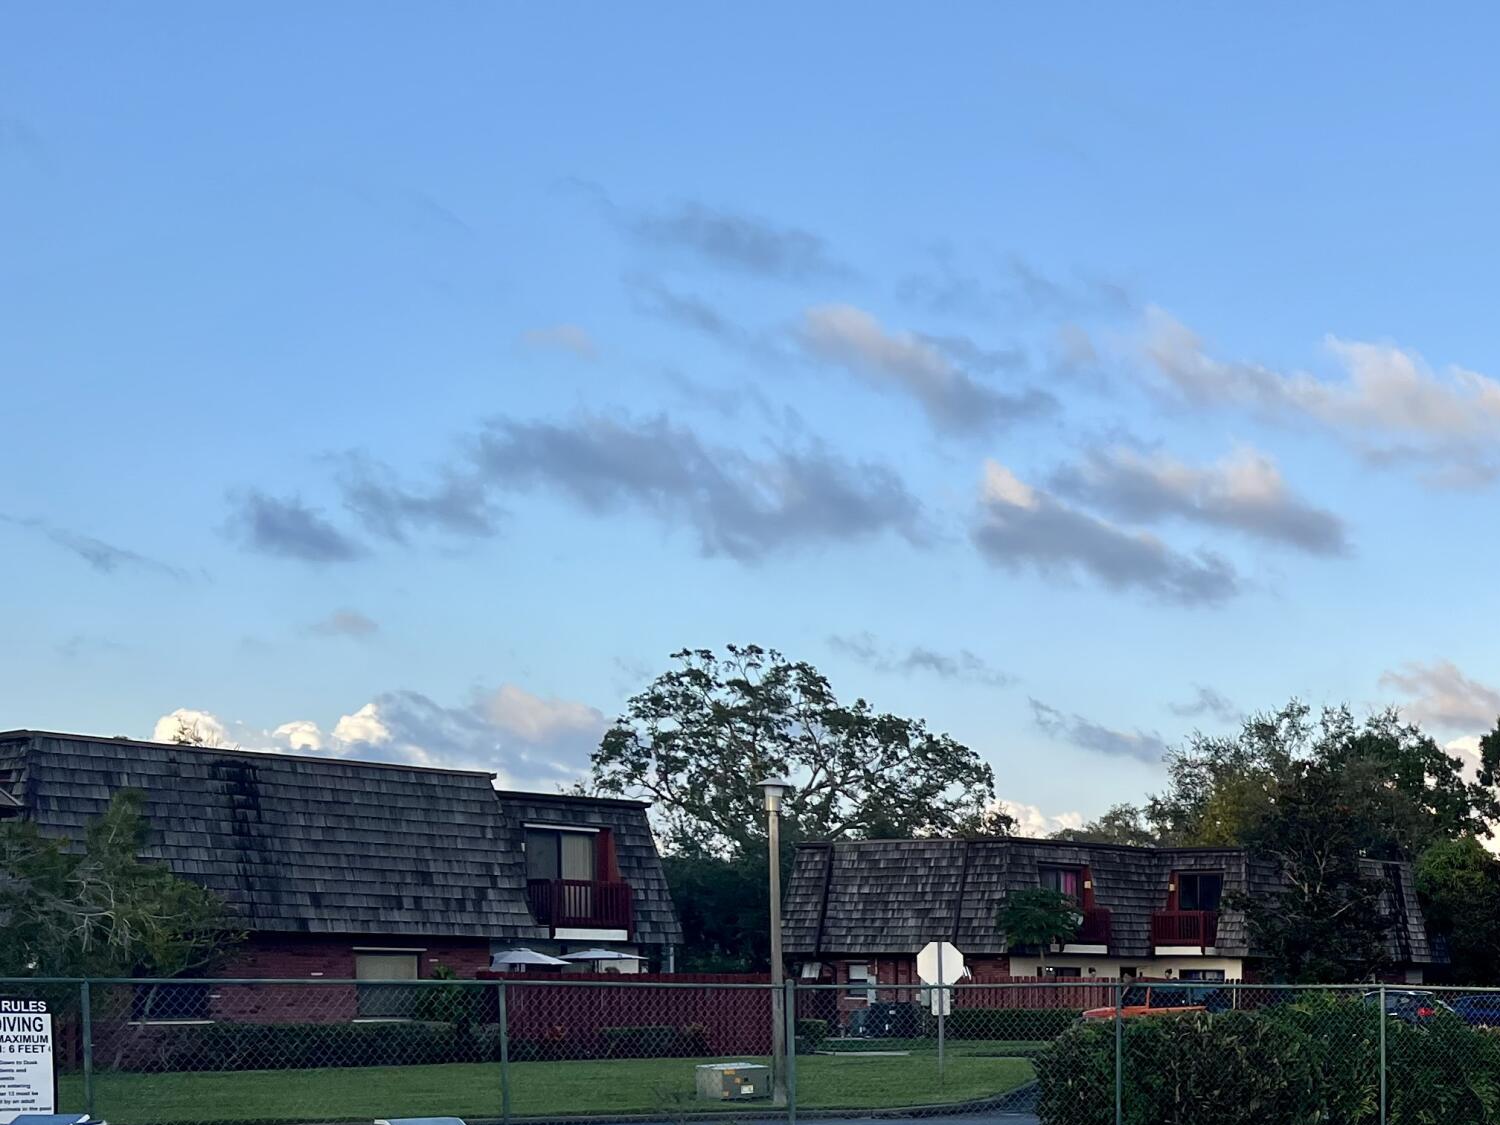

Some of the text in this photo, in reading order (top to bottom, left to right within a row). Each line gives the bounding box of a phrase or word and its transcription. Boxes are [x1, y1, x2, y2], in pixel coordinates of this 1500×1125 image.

[1, 1000, 47, 1012] RULES
[0, 1016, 44, 1032] IVING
[8, 1044, 15, 1053] 6
[18, 1044, 46, 1053] FEET
